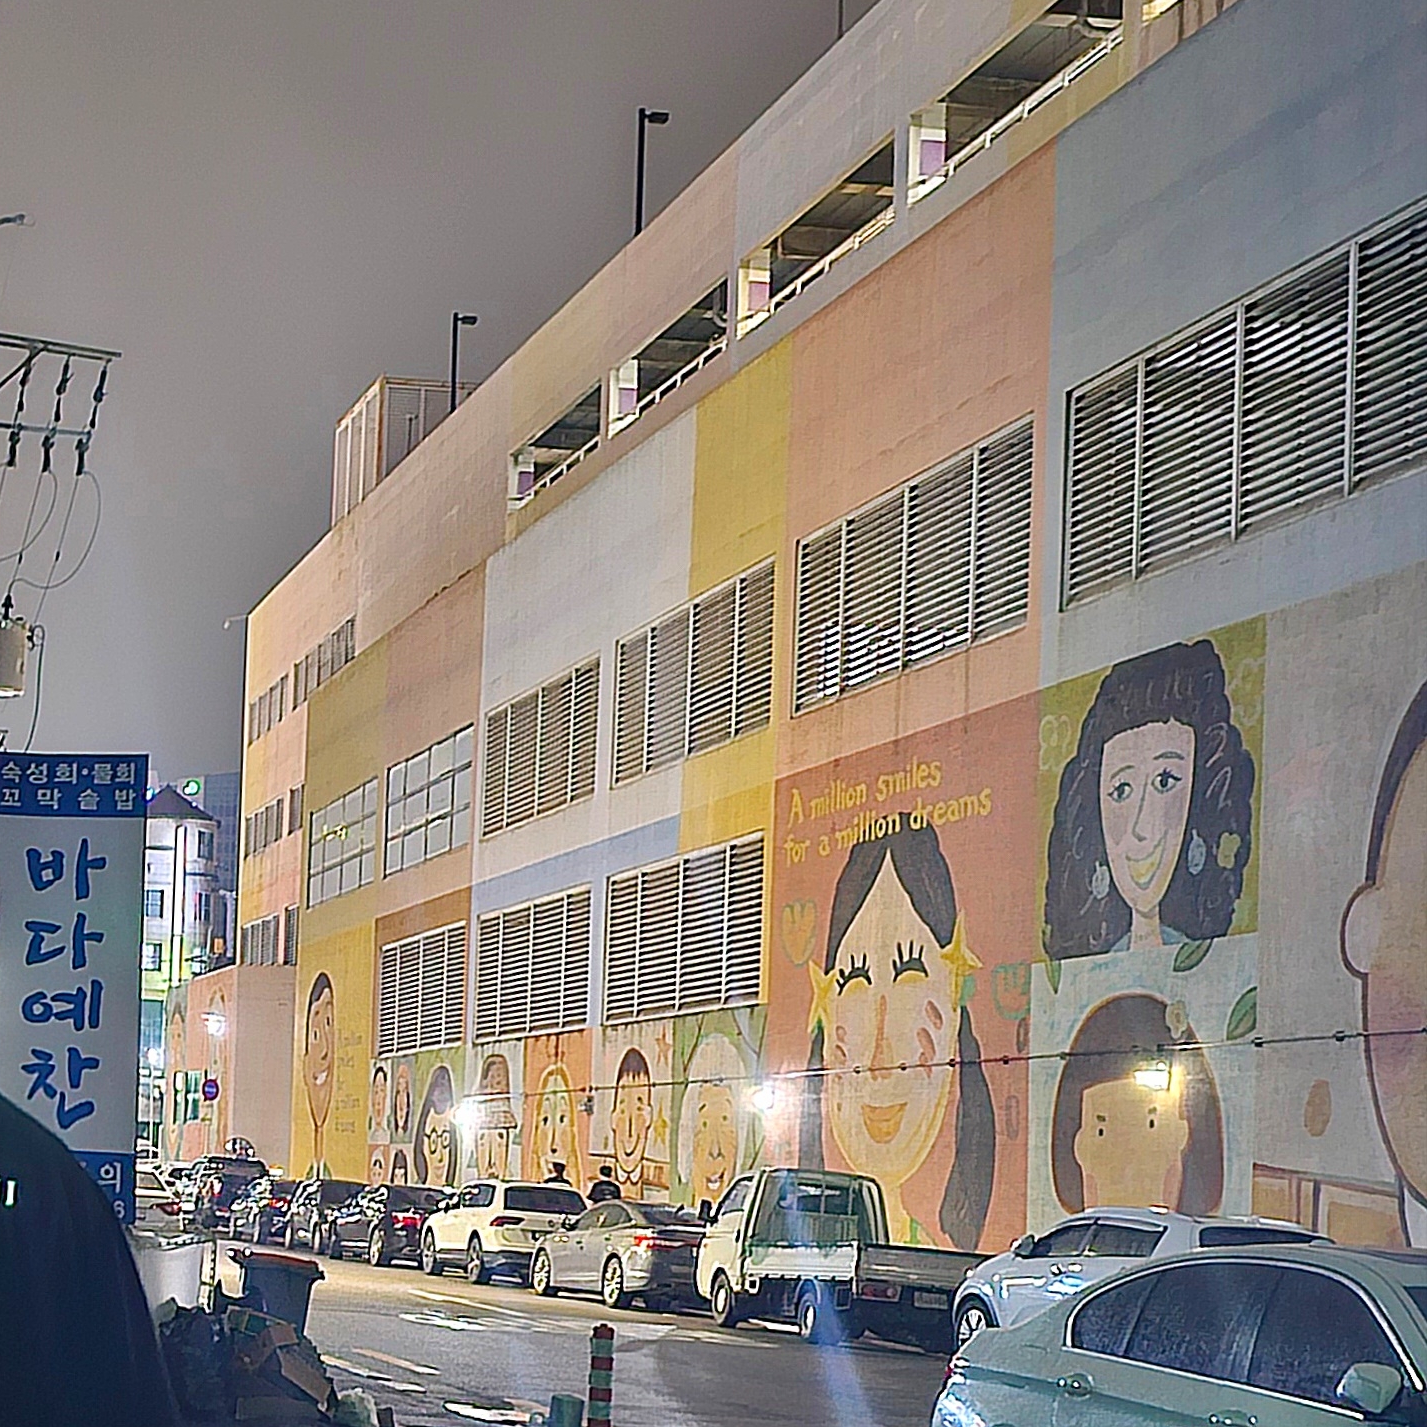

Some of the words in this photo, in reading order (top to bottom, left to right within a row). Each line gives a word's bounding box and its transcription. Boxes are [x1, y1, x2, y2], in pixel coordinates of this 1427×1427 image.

[783, 832, 810, 868] for
[818, 835, 831, 858] a
[834, 811, 901, 851] million
[908, 786, 993, 831] dreams
[787, 788, 804, 828] A
[809, 779, 868, 820] million
[874, 755, 943, 803] smiles
[21, 837, 107, 1131] 바다예찬
